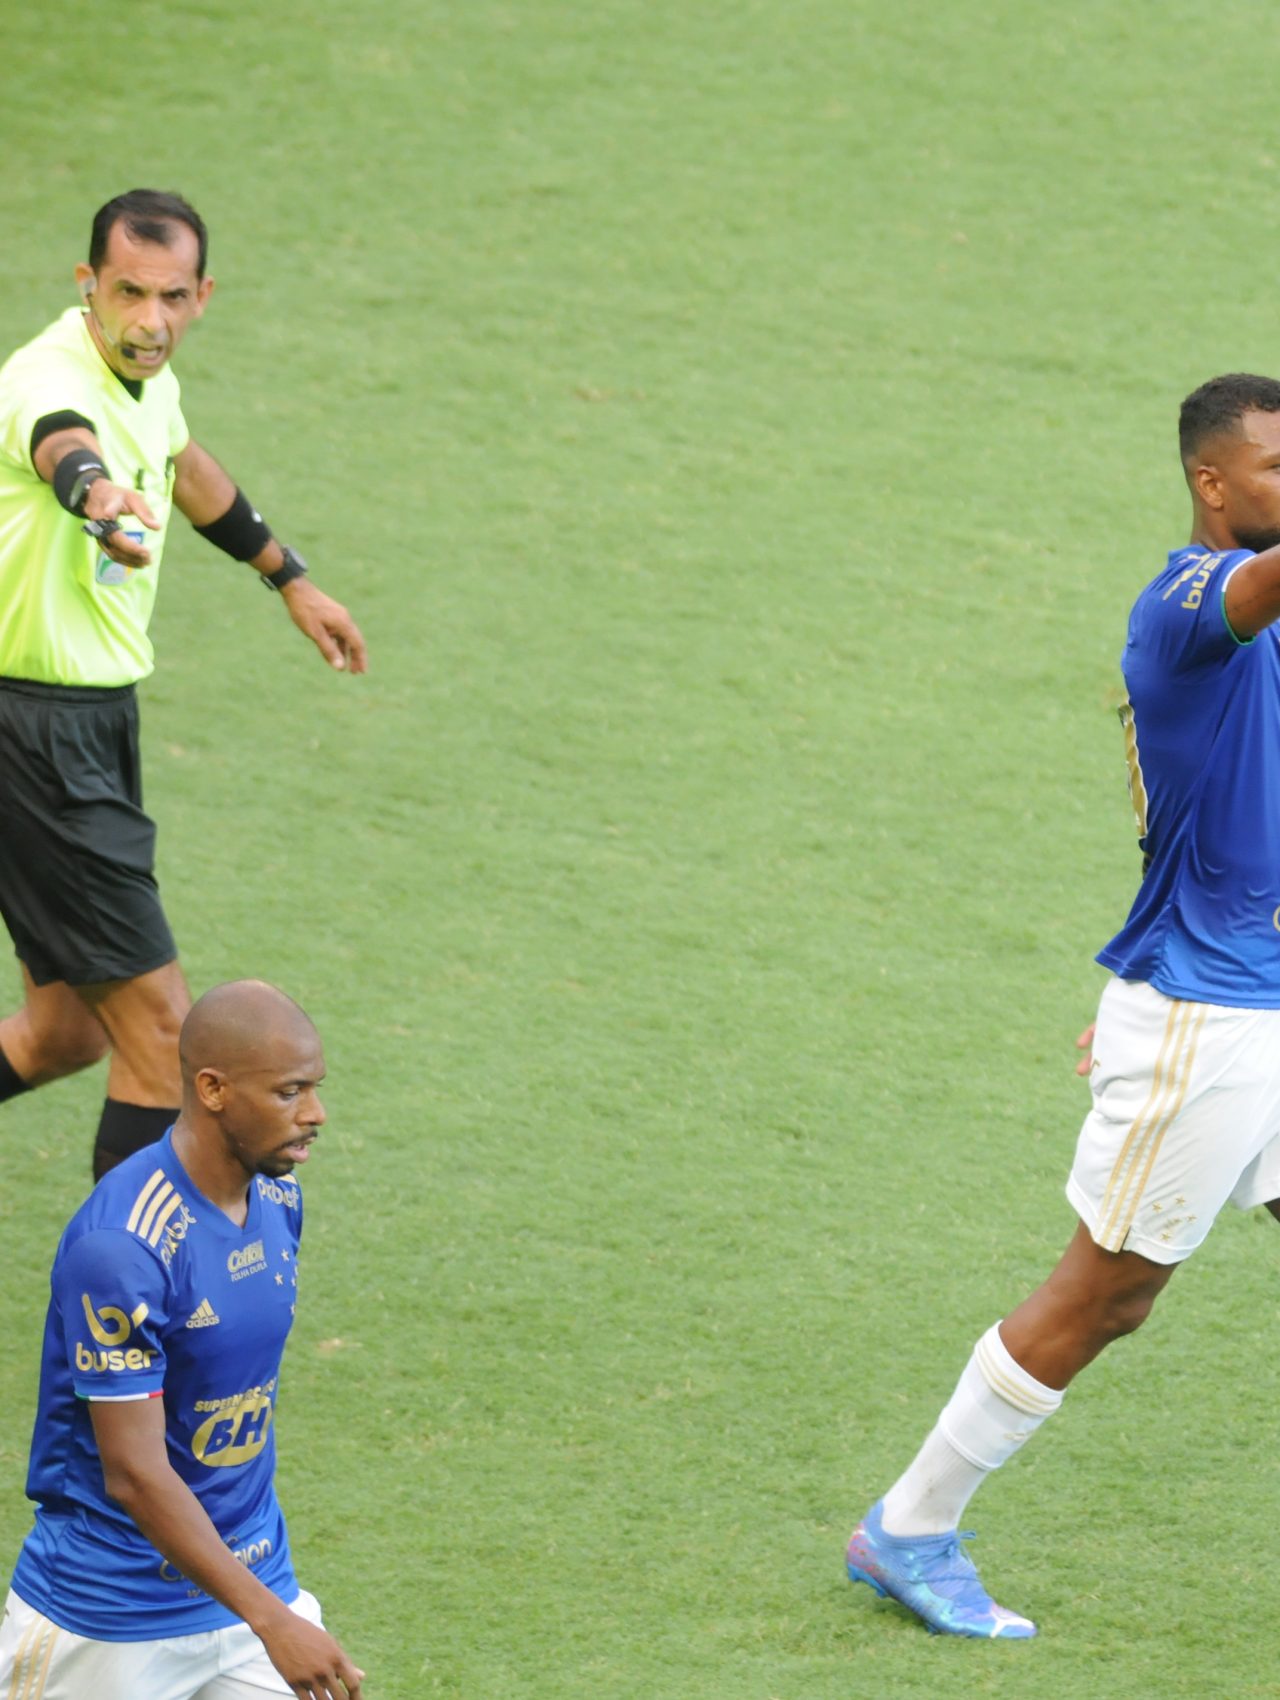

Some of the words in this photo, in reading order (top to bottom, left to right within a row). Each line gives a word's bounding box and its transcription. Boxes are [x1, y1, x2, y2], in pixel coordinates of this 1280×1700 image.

[186, 1314, 220, 1329] adidas
[76, 1341, 158, 1372] buser
[202, 1406, 269, 1458] BH
